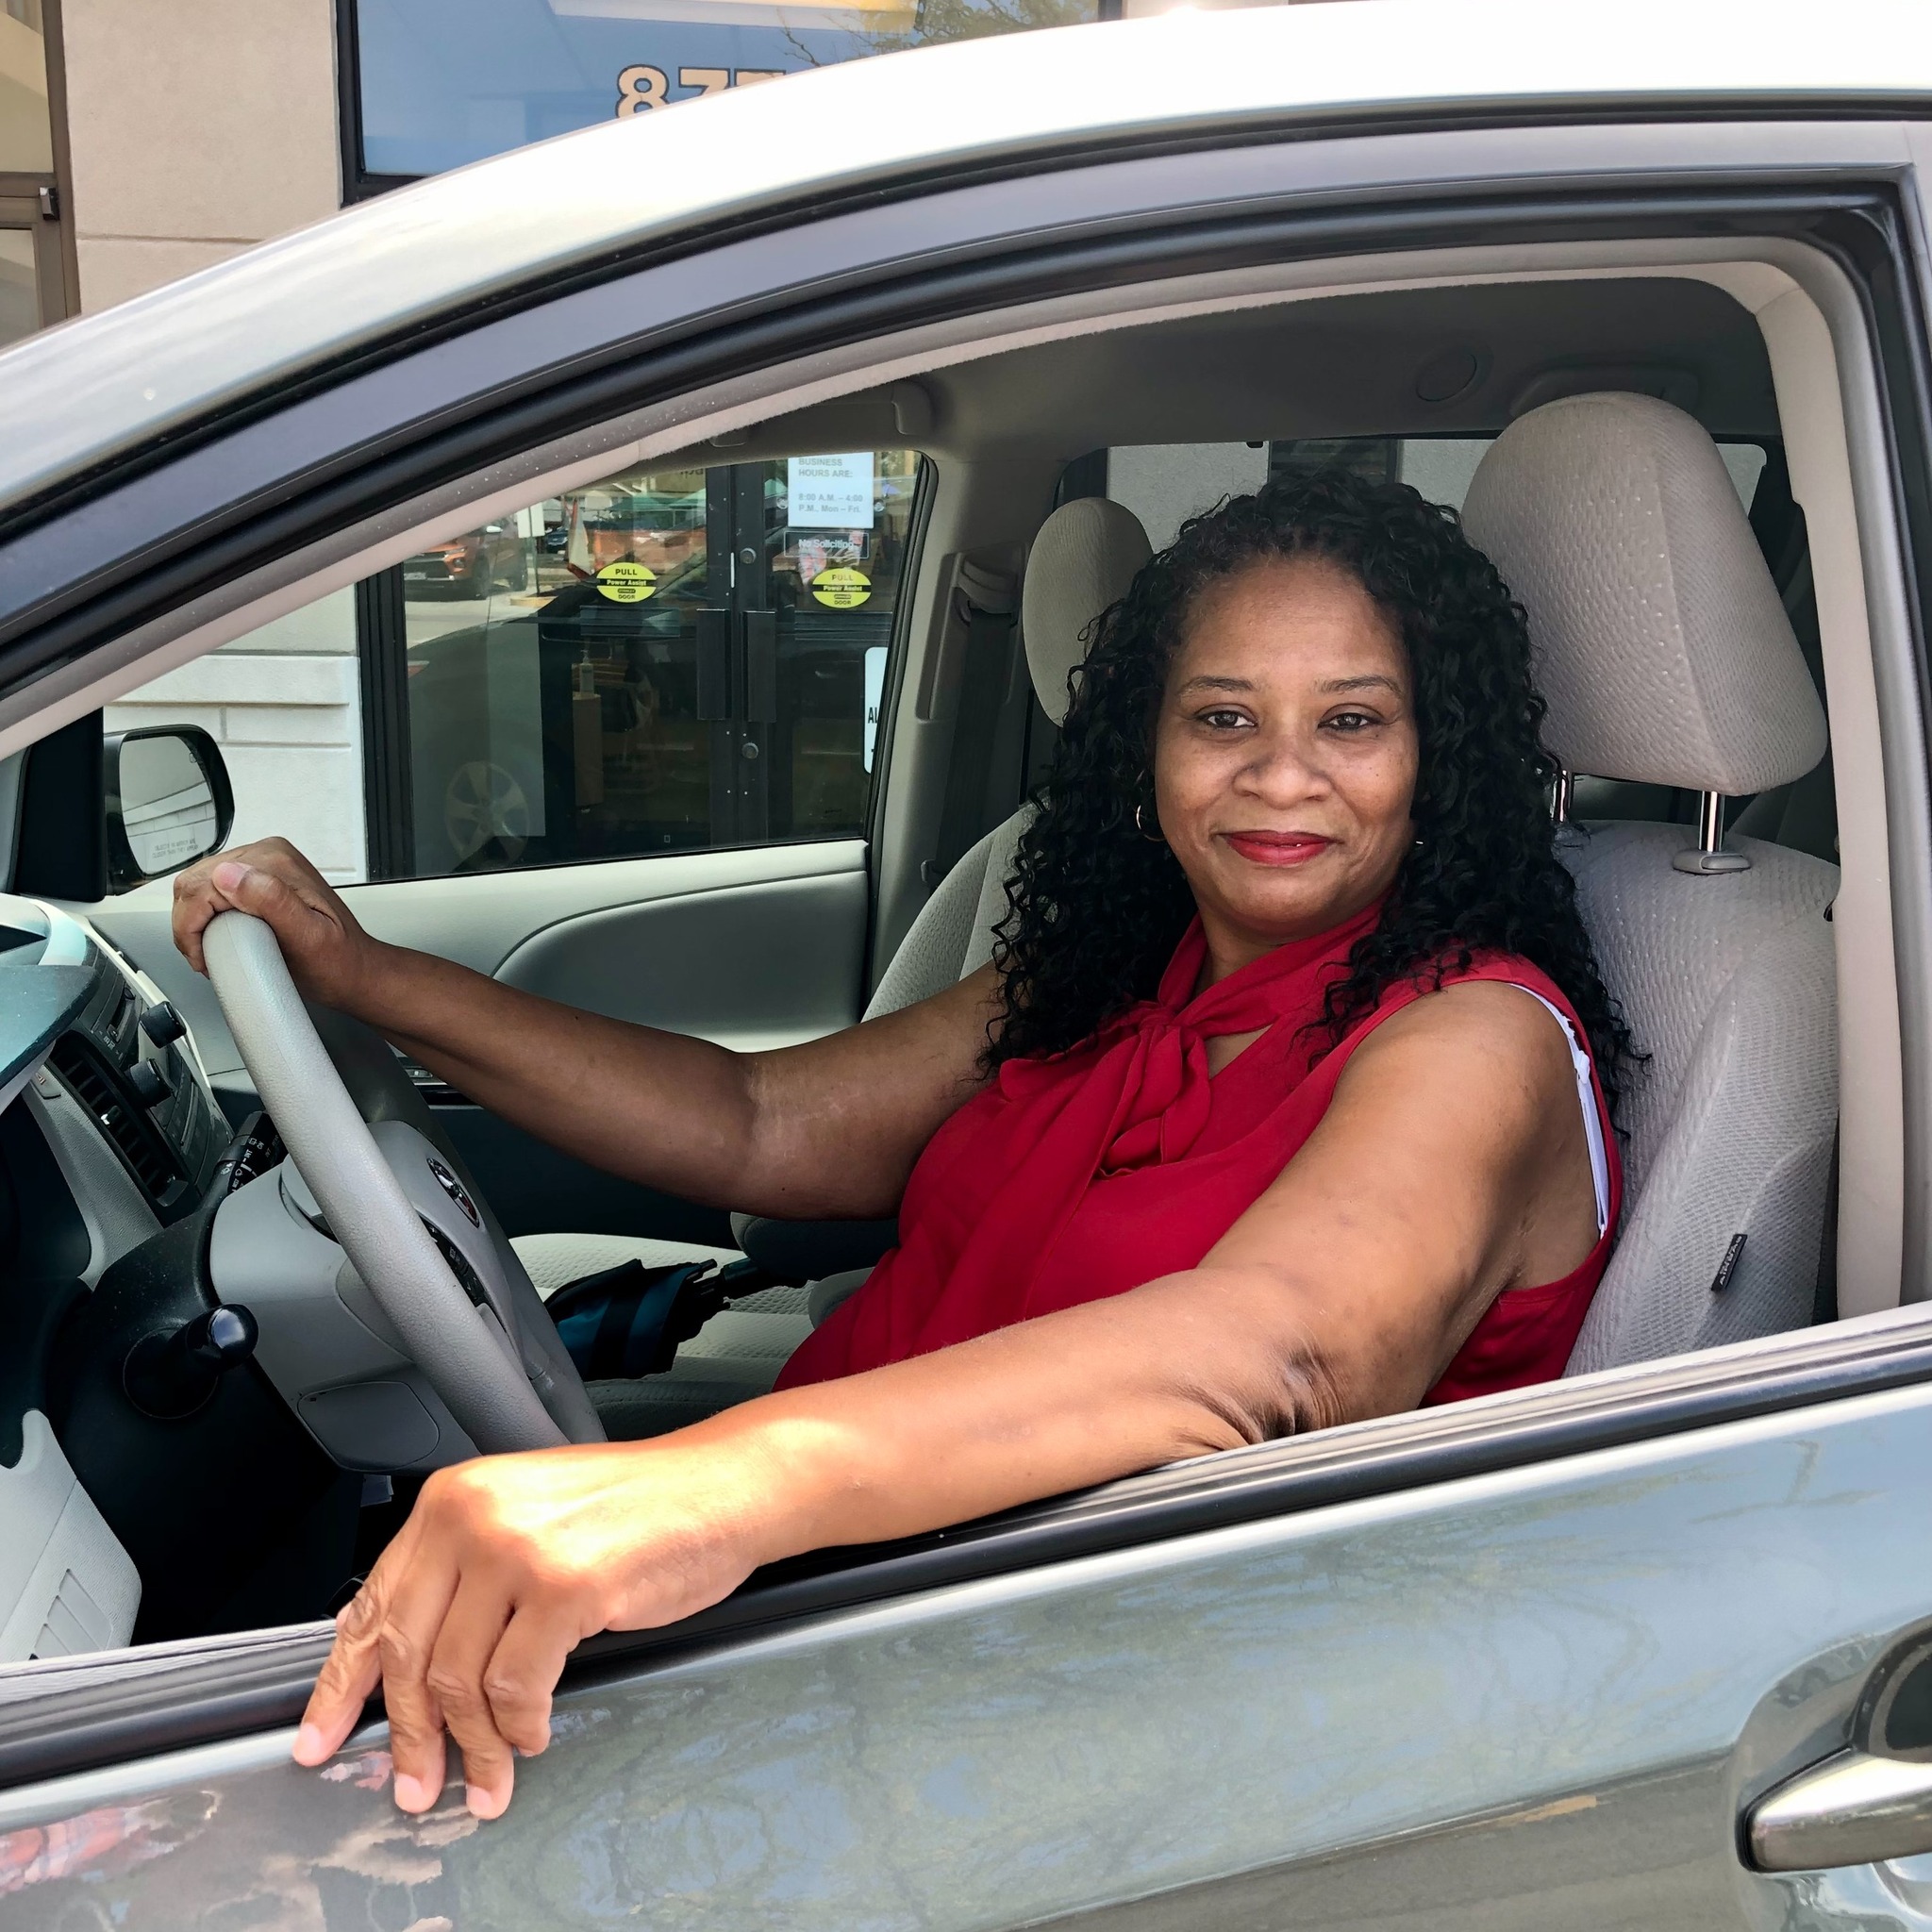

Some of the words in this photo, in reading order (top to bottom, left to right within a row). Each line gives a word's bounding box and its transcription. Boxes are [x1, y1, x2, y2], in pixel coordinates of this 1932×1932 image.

[616, 64, 786, 118] 87
[798, 458, 843, 466] BUSINESS
[798, 469, 830, 477] HOURS
[832, 469, 853, 478] ARE:
[798, 492, 817, 502] 8:00
[821, 504, 840, 513] Mon
[798, 539, 810, 548] No
